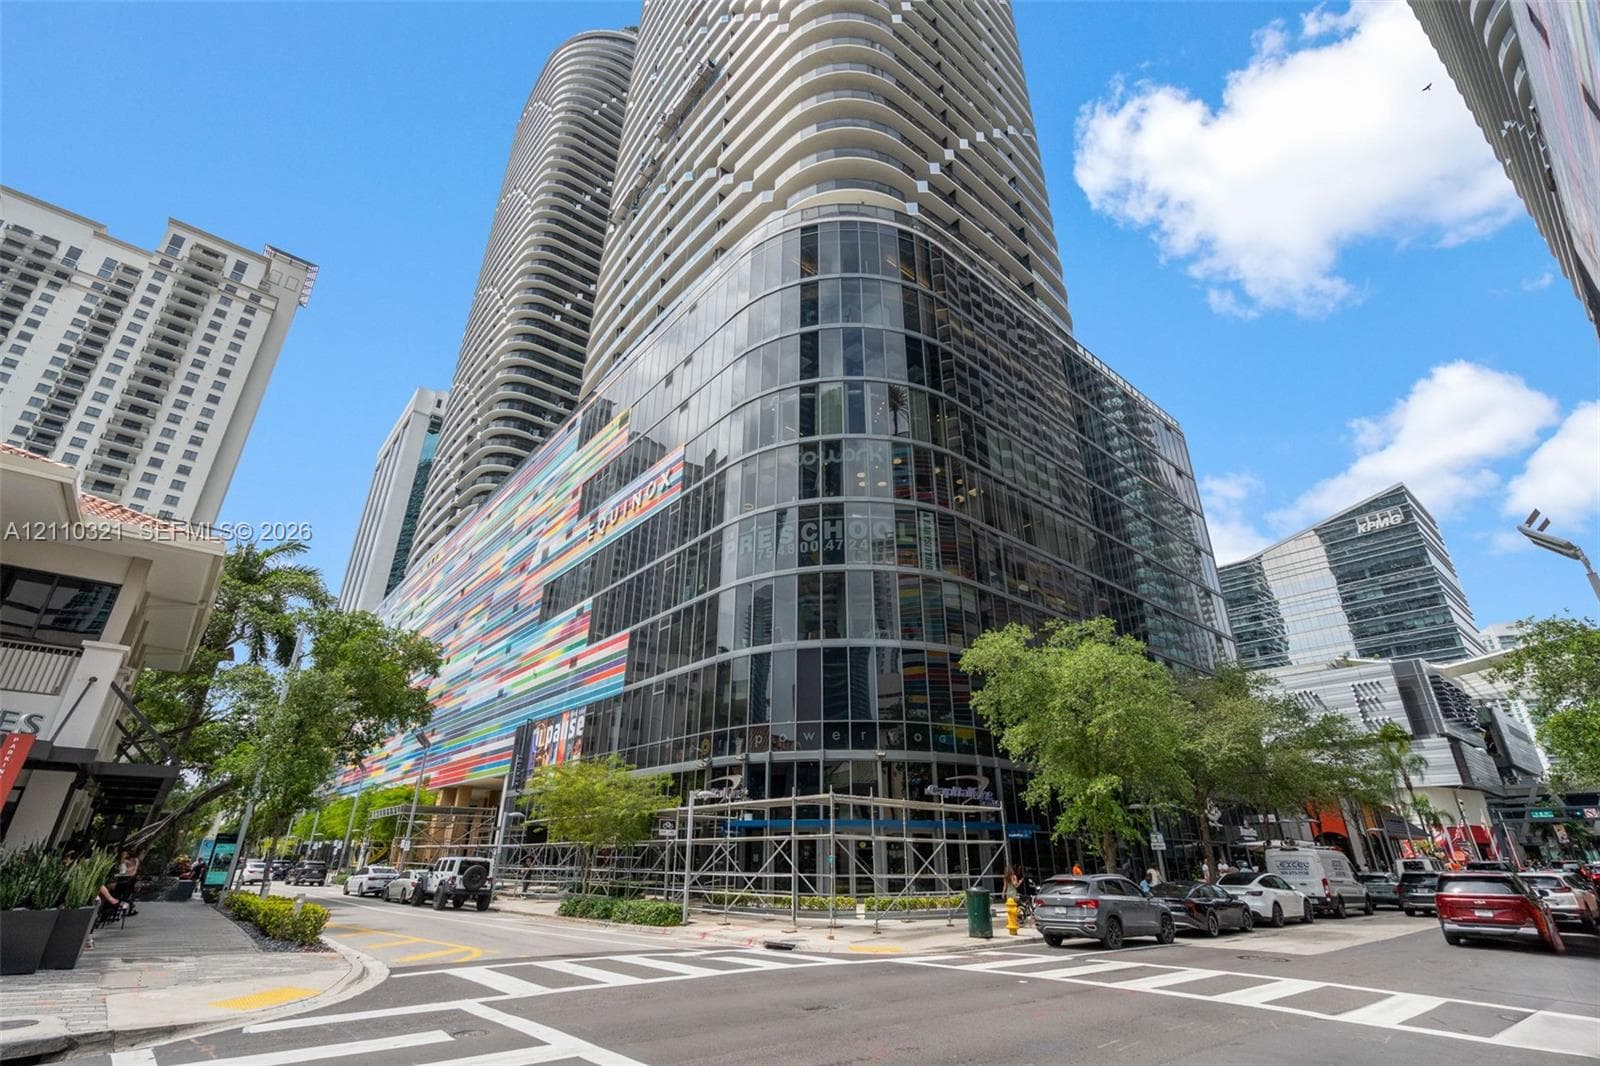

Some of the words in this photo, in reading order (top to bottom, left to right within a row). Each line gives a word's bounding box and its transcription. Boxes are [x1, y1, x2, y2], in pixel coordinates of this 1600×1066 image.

[587, 469, 672, 542] EQUINOX
[724, 520, 914, 554] PRESCHOOL
[1357, 513, 1403, 533] KPMG
[755, 730, 867, 746] power
[0, 737, 20, 780] PARKIN
